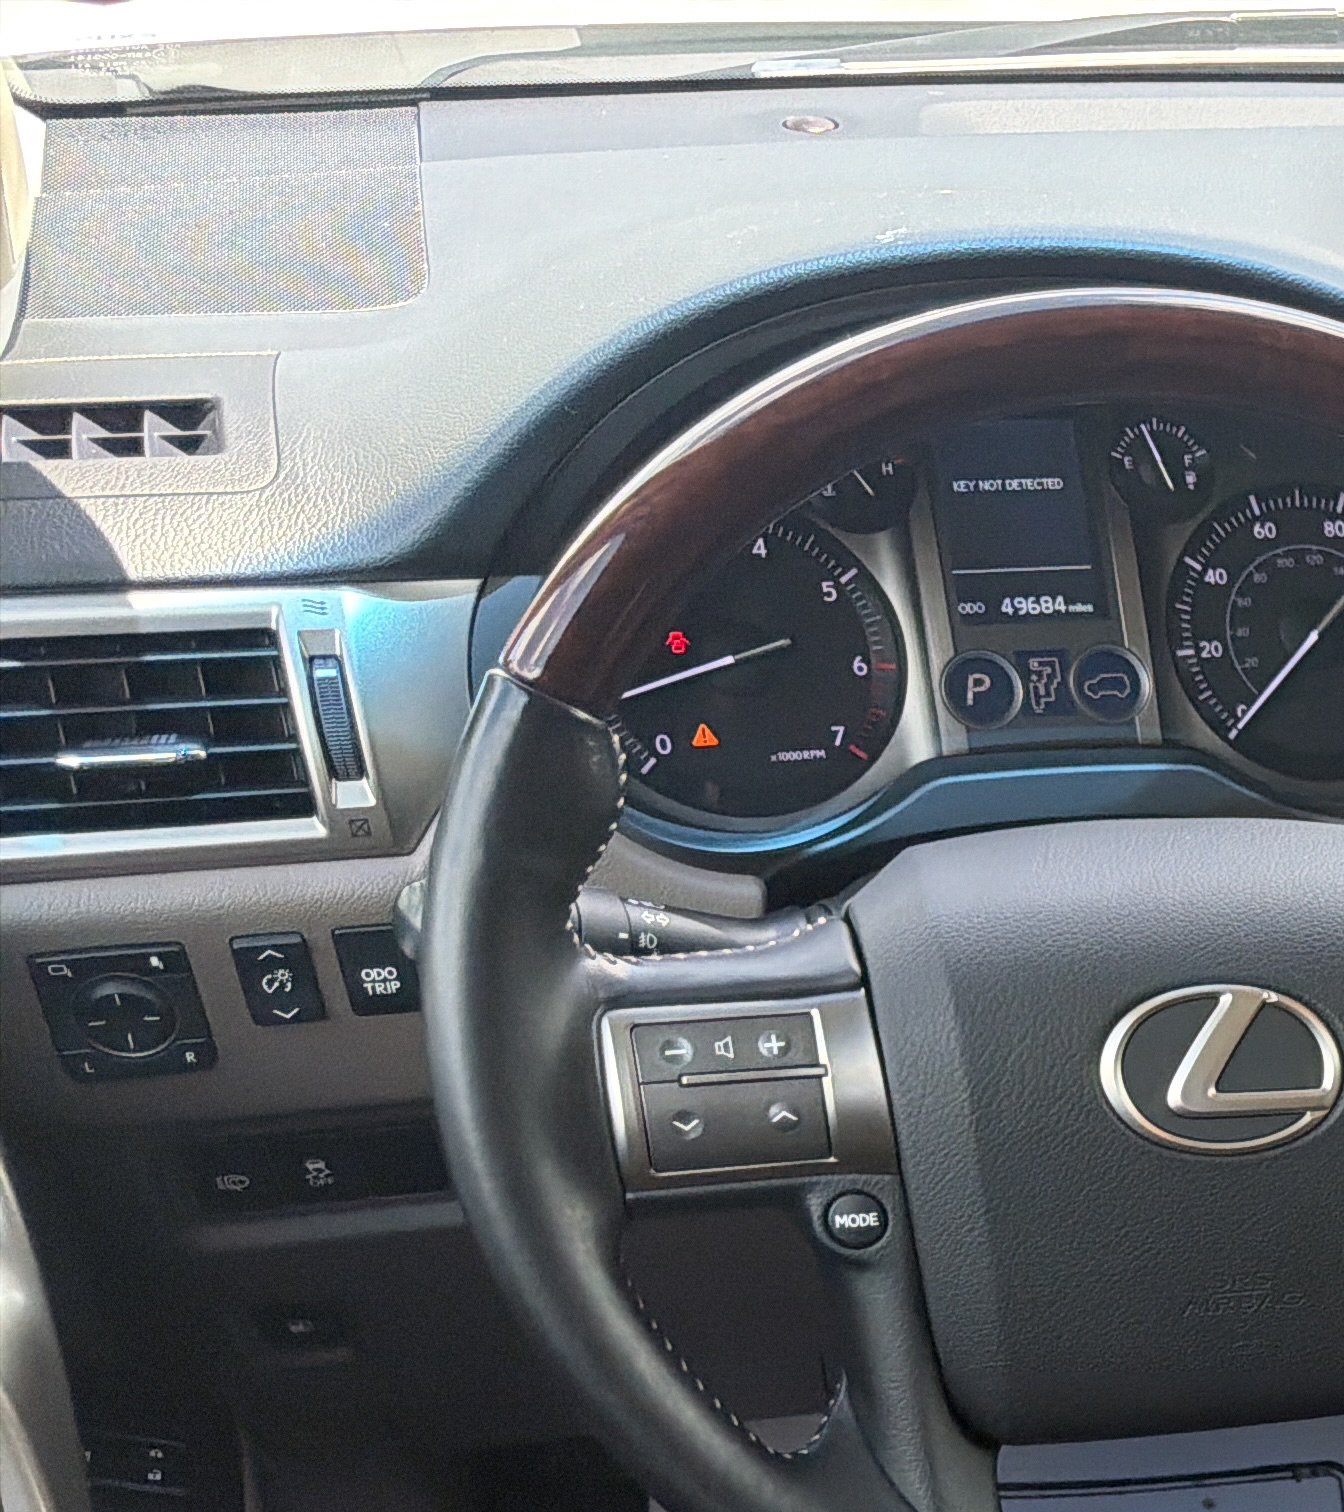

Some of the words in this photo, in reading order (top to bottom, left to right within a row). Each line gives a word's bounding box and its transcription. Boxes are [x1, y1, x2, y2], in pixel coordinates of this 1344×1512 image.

[881, 463, 893, 475] H
[1124, 456, 1133, 469] E
[953, 480, 976, 492] KEY
[979, 479, 1003, 491] NOT
[1005, 477, 1064, 491] DETECTED
[1253, 522, 1277, 539] 60
[752, 539, 767, 559] 4
[1205, 567, 1228, 586] 40
[821, 583, 838, 602] 5
[957, 602, 986, 615] ODO
[1001, 595, 1067, 616] 49684
[1068, 603, 1094, 613] miles
[1200, 640, 1223, 659] 20
[852, 656, 869, 676] 6
[655, 735, 673, 755] 0
[831, 726, 845, 747] 7
[361, 967, 397, 982] ODO
[363, 981, 401, 996] TRIP
[186, 1051, 197, 1064] R
[85, 1061, 94, 1073] L
[834, 1212, 880, 1229] MODE
